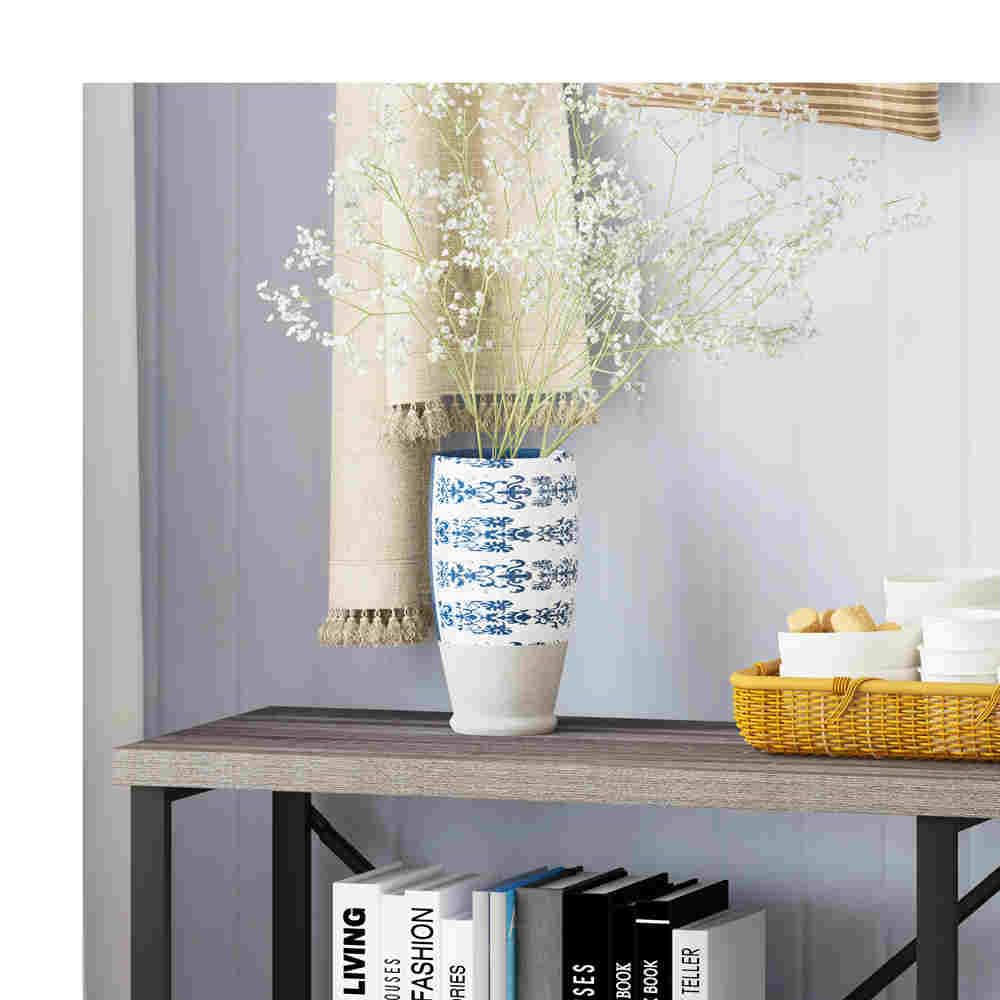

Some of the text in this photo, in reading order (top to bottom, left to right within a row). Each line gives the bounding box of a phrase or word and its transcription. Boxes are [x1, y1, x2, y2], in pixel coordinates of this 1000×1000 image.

[343, 907, 366, 995] LIVING
[681, 947, 701, 995] TELLER
[615, 962, 632, 999] BOOK
[643, 960, 659, 994] BOOK
